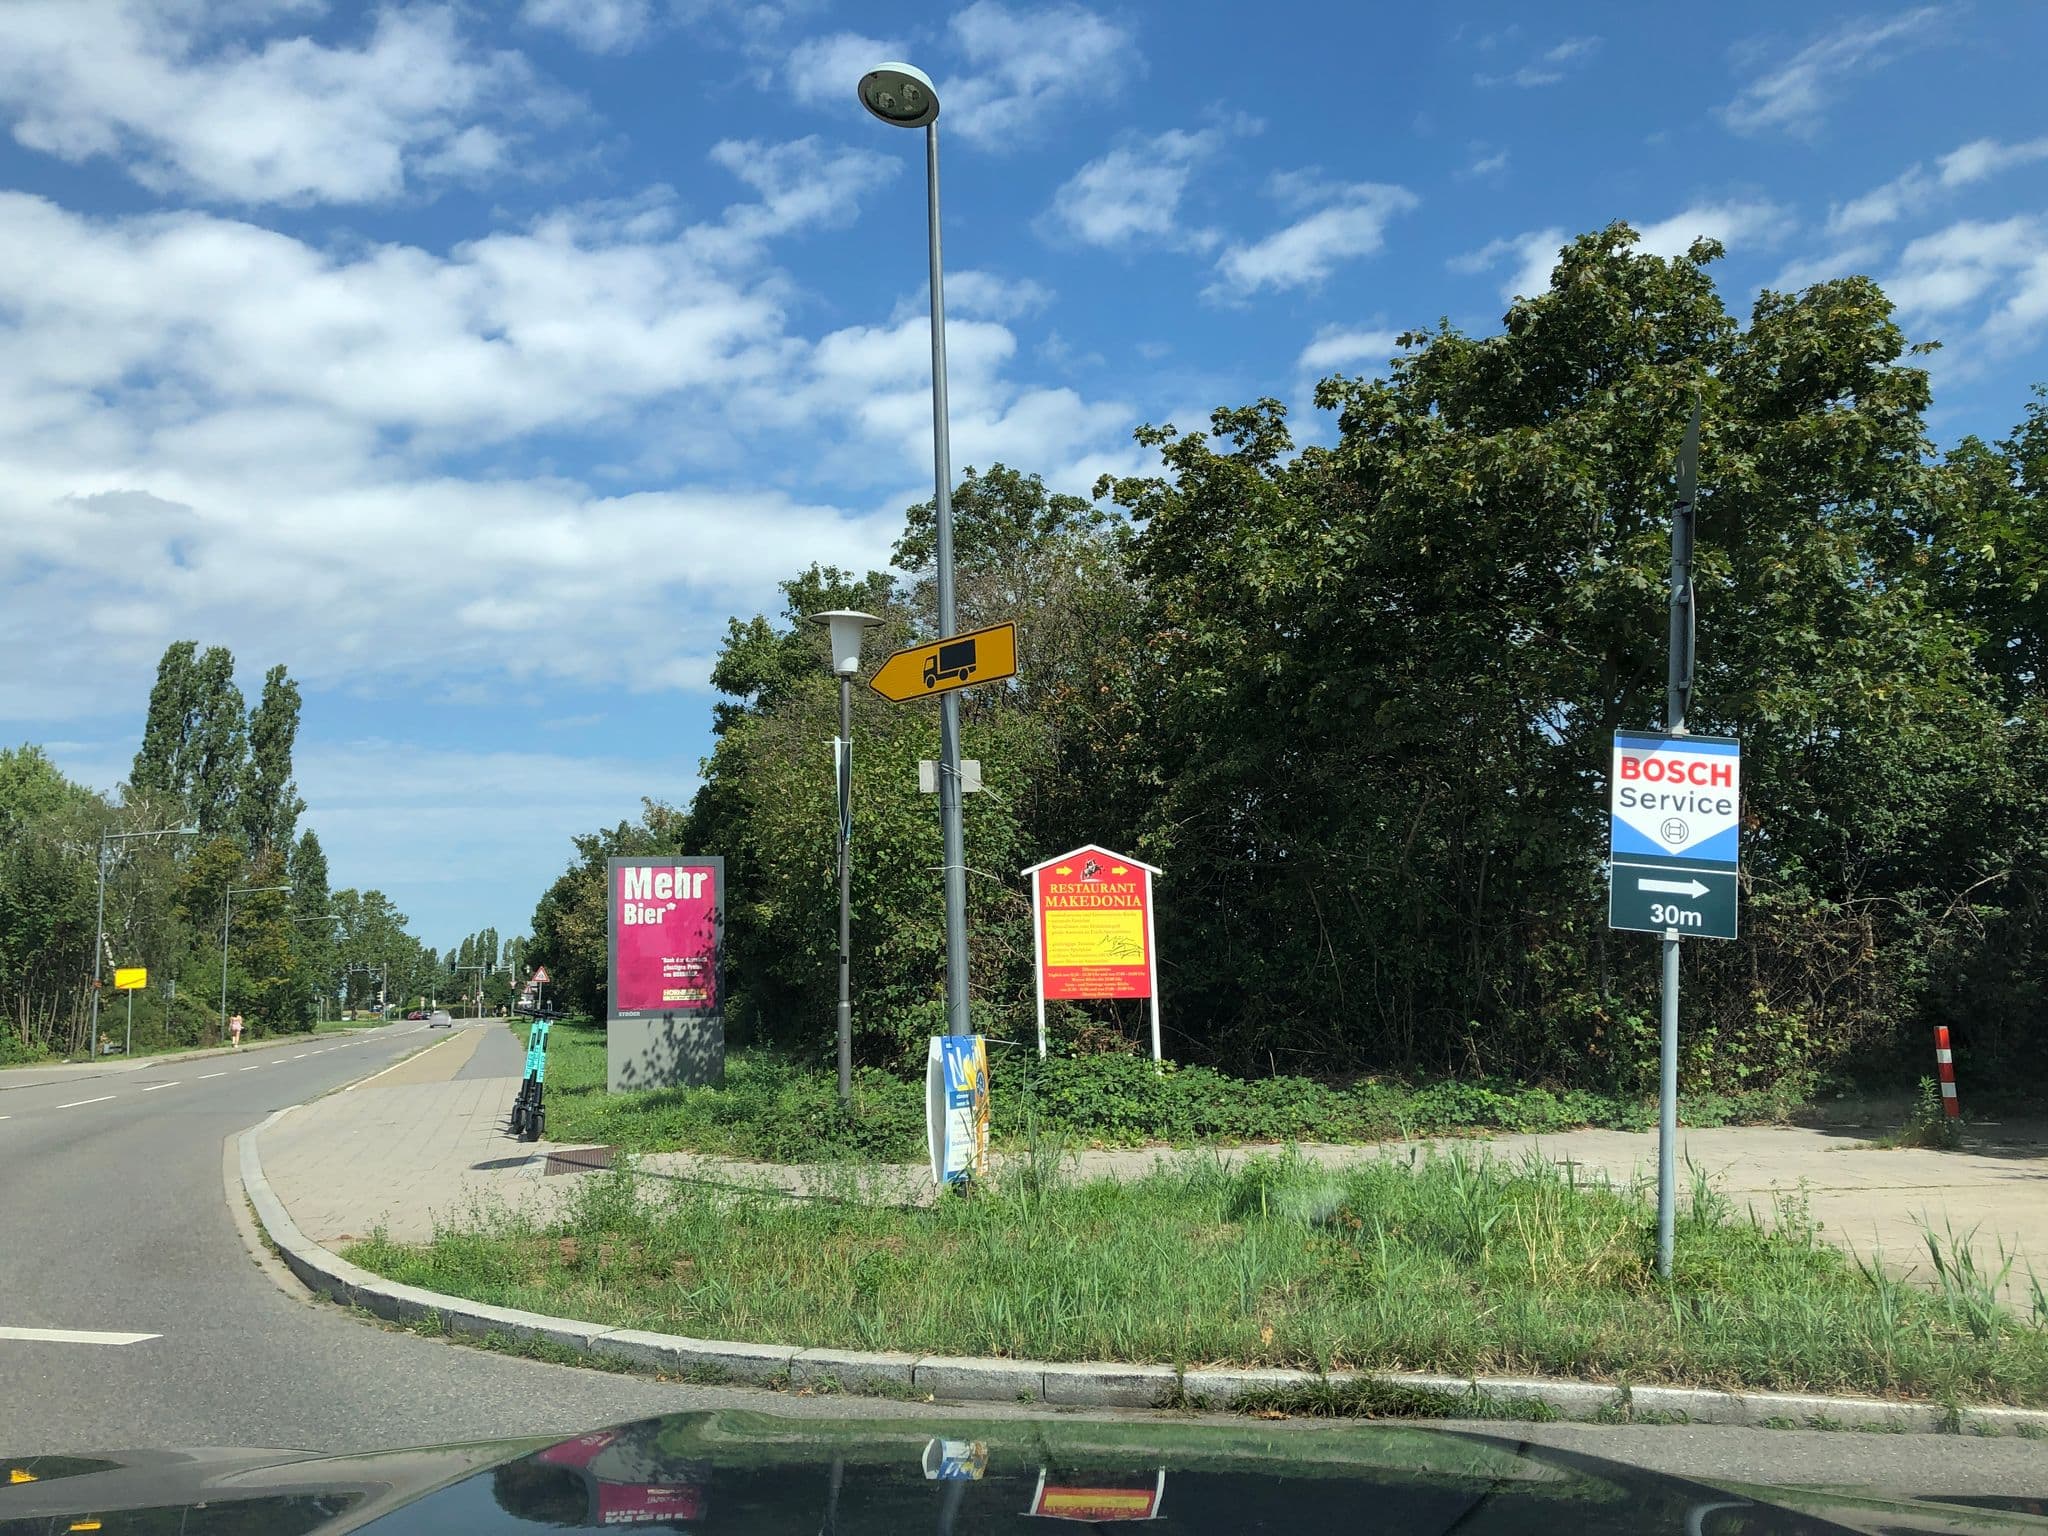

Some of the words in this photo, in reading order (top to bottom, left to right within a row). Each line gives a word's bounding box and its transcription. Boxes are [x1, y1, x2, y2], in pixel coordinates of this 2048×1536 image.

[1620, 756, 1732, 787] BOSCH
[1619, 787, 1732, 816] Service
[624, 866, 708, 900] Mehr
[1050, 883, 1136, 893] RESTAURANT
[1045, 895, 1142, 907] MAKEDONIA
[1650, 903, 1702, 927] 30m
